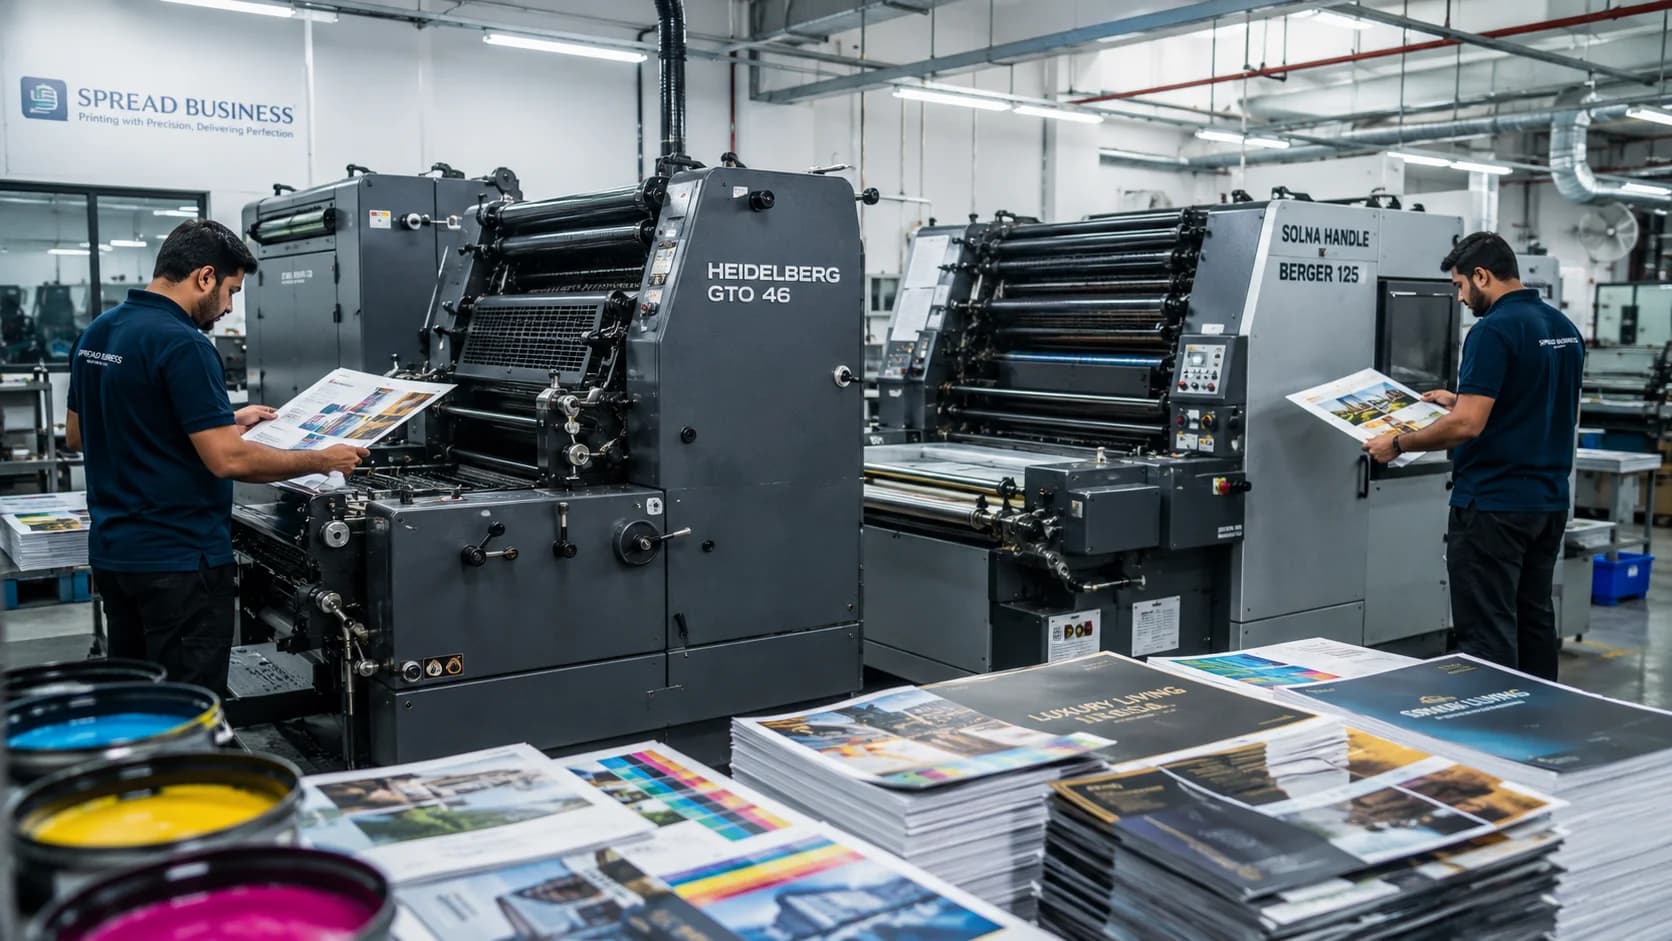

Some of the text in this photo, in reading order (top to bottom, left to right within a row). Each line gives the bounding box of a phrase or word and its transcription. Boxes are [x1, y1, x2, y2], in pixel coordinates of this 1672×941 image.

[78, 87, 294, 125] SPREAD BUSINESS
[78, 112, 294, 139] Printing with Precision, Delivering Perfection
[1282, 224, 1370, 248] SOLNA HANDLE
[707, 262, 841, 283] HEIDELBERG
[1279, 262, 1360, 284] BERGER 125
[707, 285, 791, 303] GTO 46
[1028, 700, 1114, 722] LUXURY
[1112, 686, 1187, 705] LIVING
